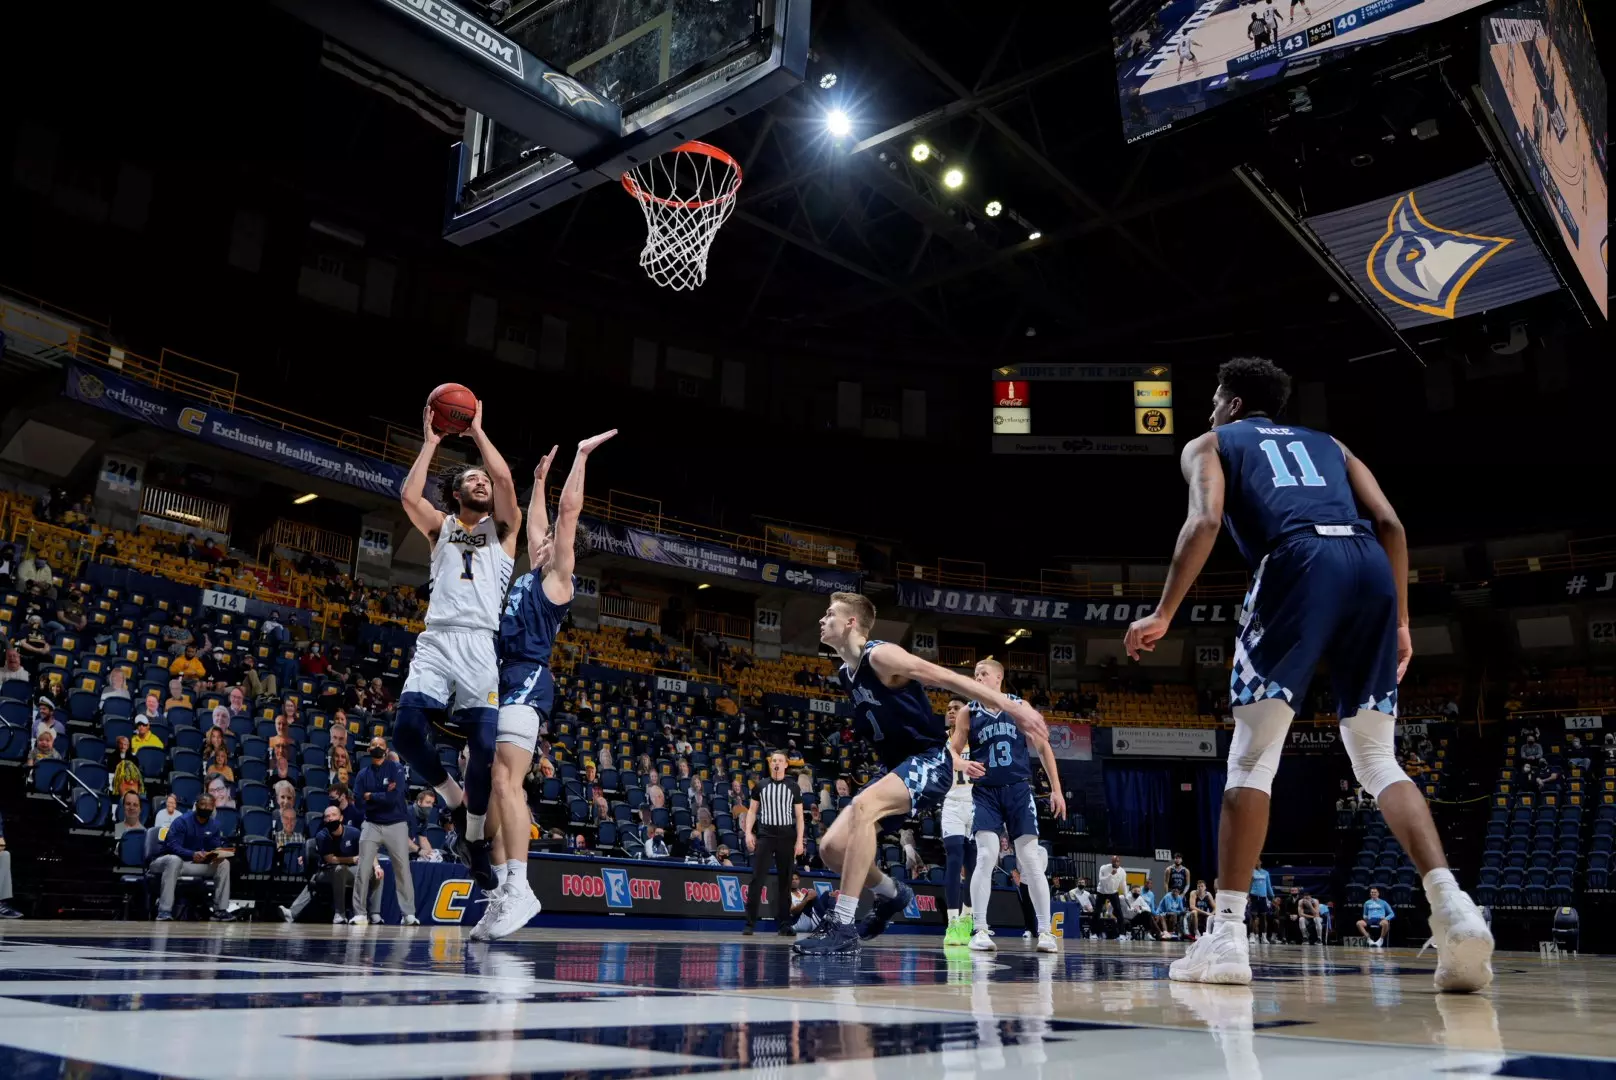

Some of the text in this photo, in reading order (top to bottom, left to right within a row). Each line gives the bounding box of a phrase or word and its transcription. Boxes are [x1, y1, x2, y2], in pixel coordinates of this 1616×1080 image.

[1310, 22, 1332, 36] 16:01
[1337, 14, 1357, 29] 40
[1284, 36, 1303, 51] 43
[1236, 44, 1277, 64] THE CITADEL
[1127, 123, 1172, 144] DAKTRONICS
[106, 388, 168, 416] erlanger
[212, 421, 273, 450] Exclusive
[276, 441, 342, 472] Healthcare
[344, 462, 394, 488] Provider
[1254, 427, 1295, 436] RICE
[1120, 443, 1149, 452] Optics
[108, 459, 137, 482] 214
[1259, 439, 1327, 488] 11
[364, 529, 389, 550] 215
[663, 540, 758, 569] Official Internet And
[460, 549, 474, 581] 1
[684, 556, 738, 576] TV Partner
[576, 577, 596, 595] 216
[785, 569, 814, 585] epb
[816, 578, 834, 589] Fiber
[834, 582, 857, 593] Optics
[1565, 574, 1588, 595] #
[212, 593, 238, 610] 114
[926, 589, 997, 613] JOIN
[1012, 598, 1070, 620] THE
[1084, 603, 1153, 621] MOC
[758, 610, 778, 627] 217
[1592, 622, 1616, 638] 22
[916, 634, 934, 649] 218
[1053, 646, 1073, 660] 219
[1200, 648, 1220, 662] 219
[663, 678, 681, 691] 115
[814, 700, 831, 712] 116
[1402, 725, 1422, 735] 120
[1571, 718, 1595, 728] 121
[1291, 731, 1336, 744] FALLS
[989, 740, 1012, 768] 13
[1156, 850, 1170, 860] 117
[562, 874, 662, 900] FOOD CITY
[684, 881, 769, 904] FOOD CY
[915, 894, 938, 912] CITY
